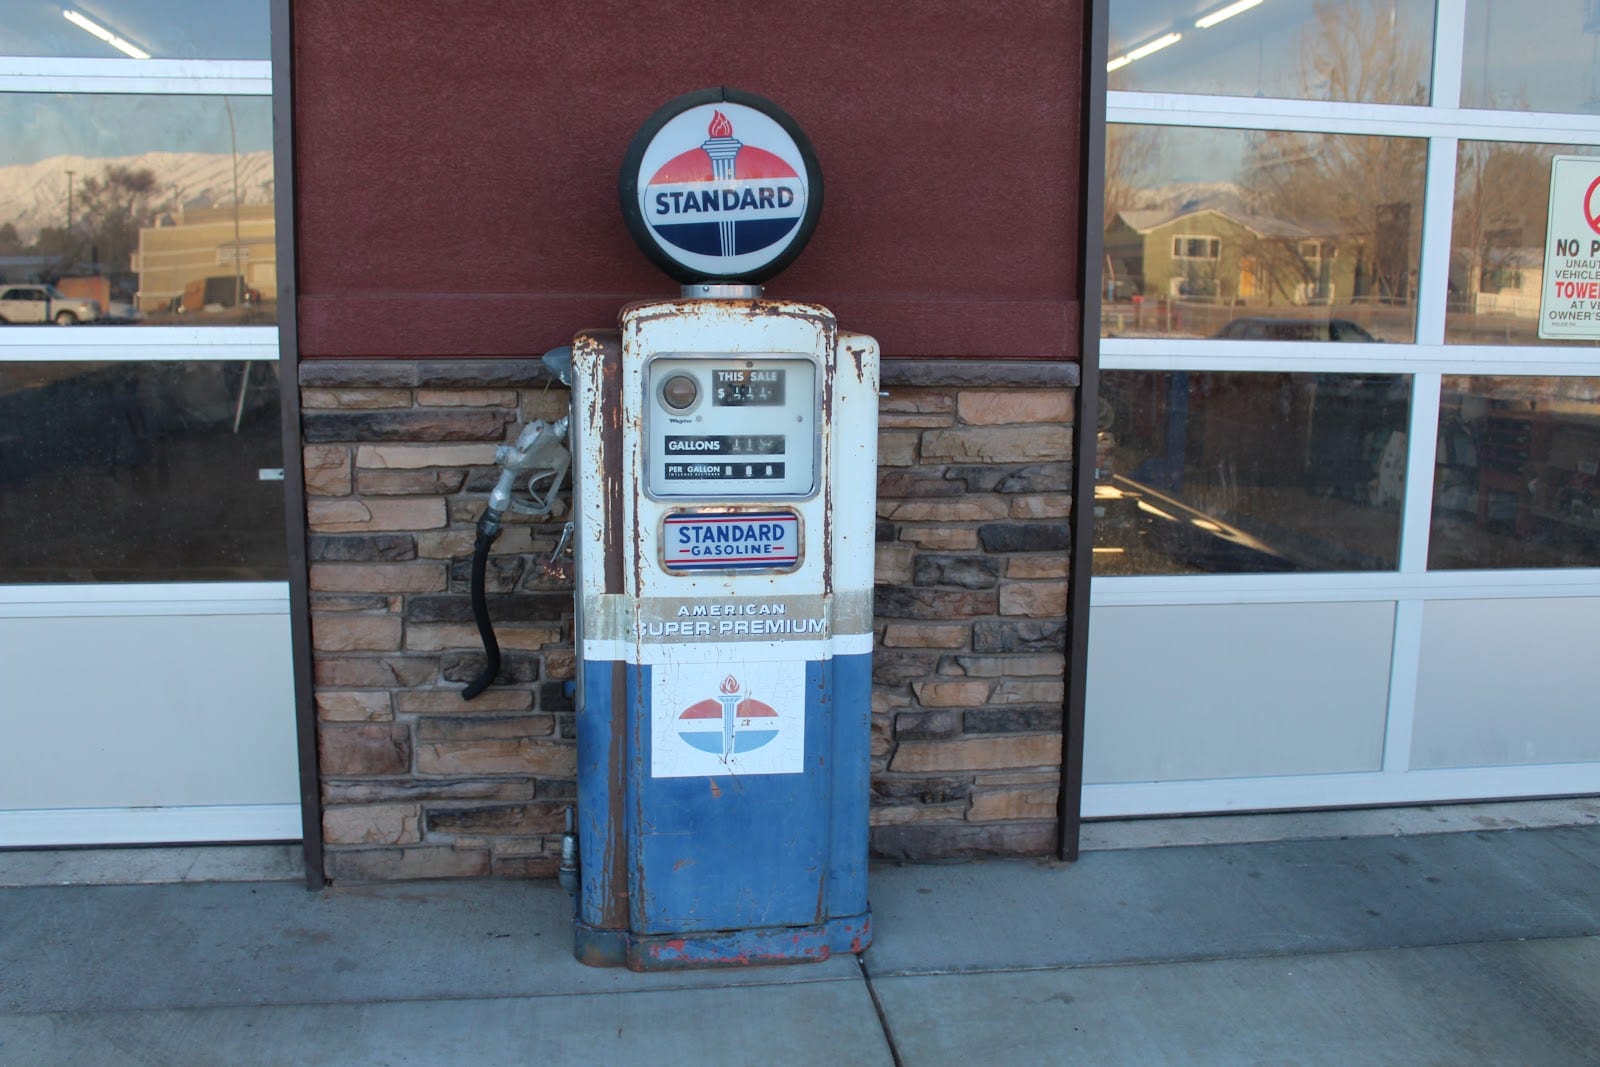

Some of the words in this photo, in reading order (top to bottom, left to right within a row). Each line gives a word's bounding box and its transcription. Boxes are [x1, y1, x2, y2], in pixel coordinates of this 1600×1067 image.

[655, 186, 794, 215] STANDARD
[1556, 238, 1580, 257] NO
[1555, 281, 1600, 299] TOWE
[1570, 300, 1585, 310] AT
[718, 371, 744, 382] THIS
[750, 371, 777, 381] SALE
[668, 440, 721, 451] GALLONS
[668, 465, 684, 473] PER
[687, 465, 720, 473] GALLON
[678, 524, 785, 544] STANDARD
[691, 544, 772, 556] GASOLINE
[677, 603, 786, 617] AMERICAN
